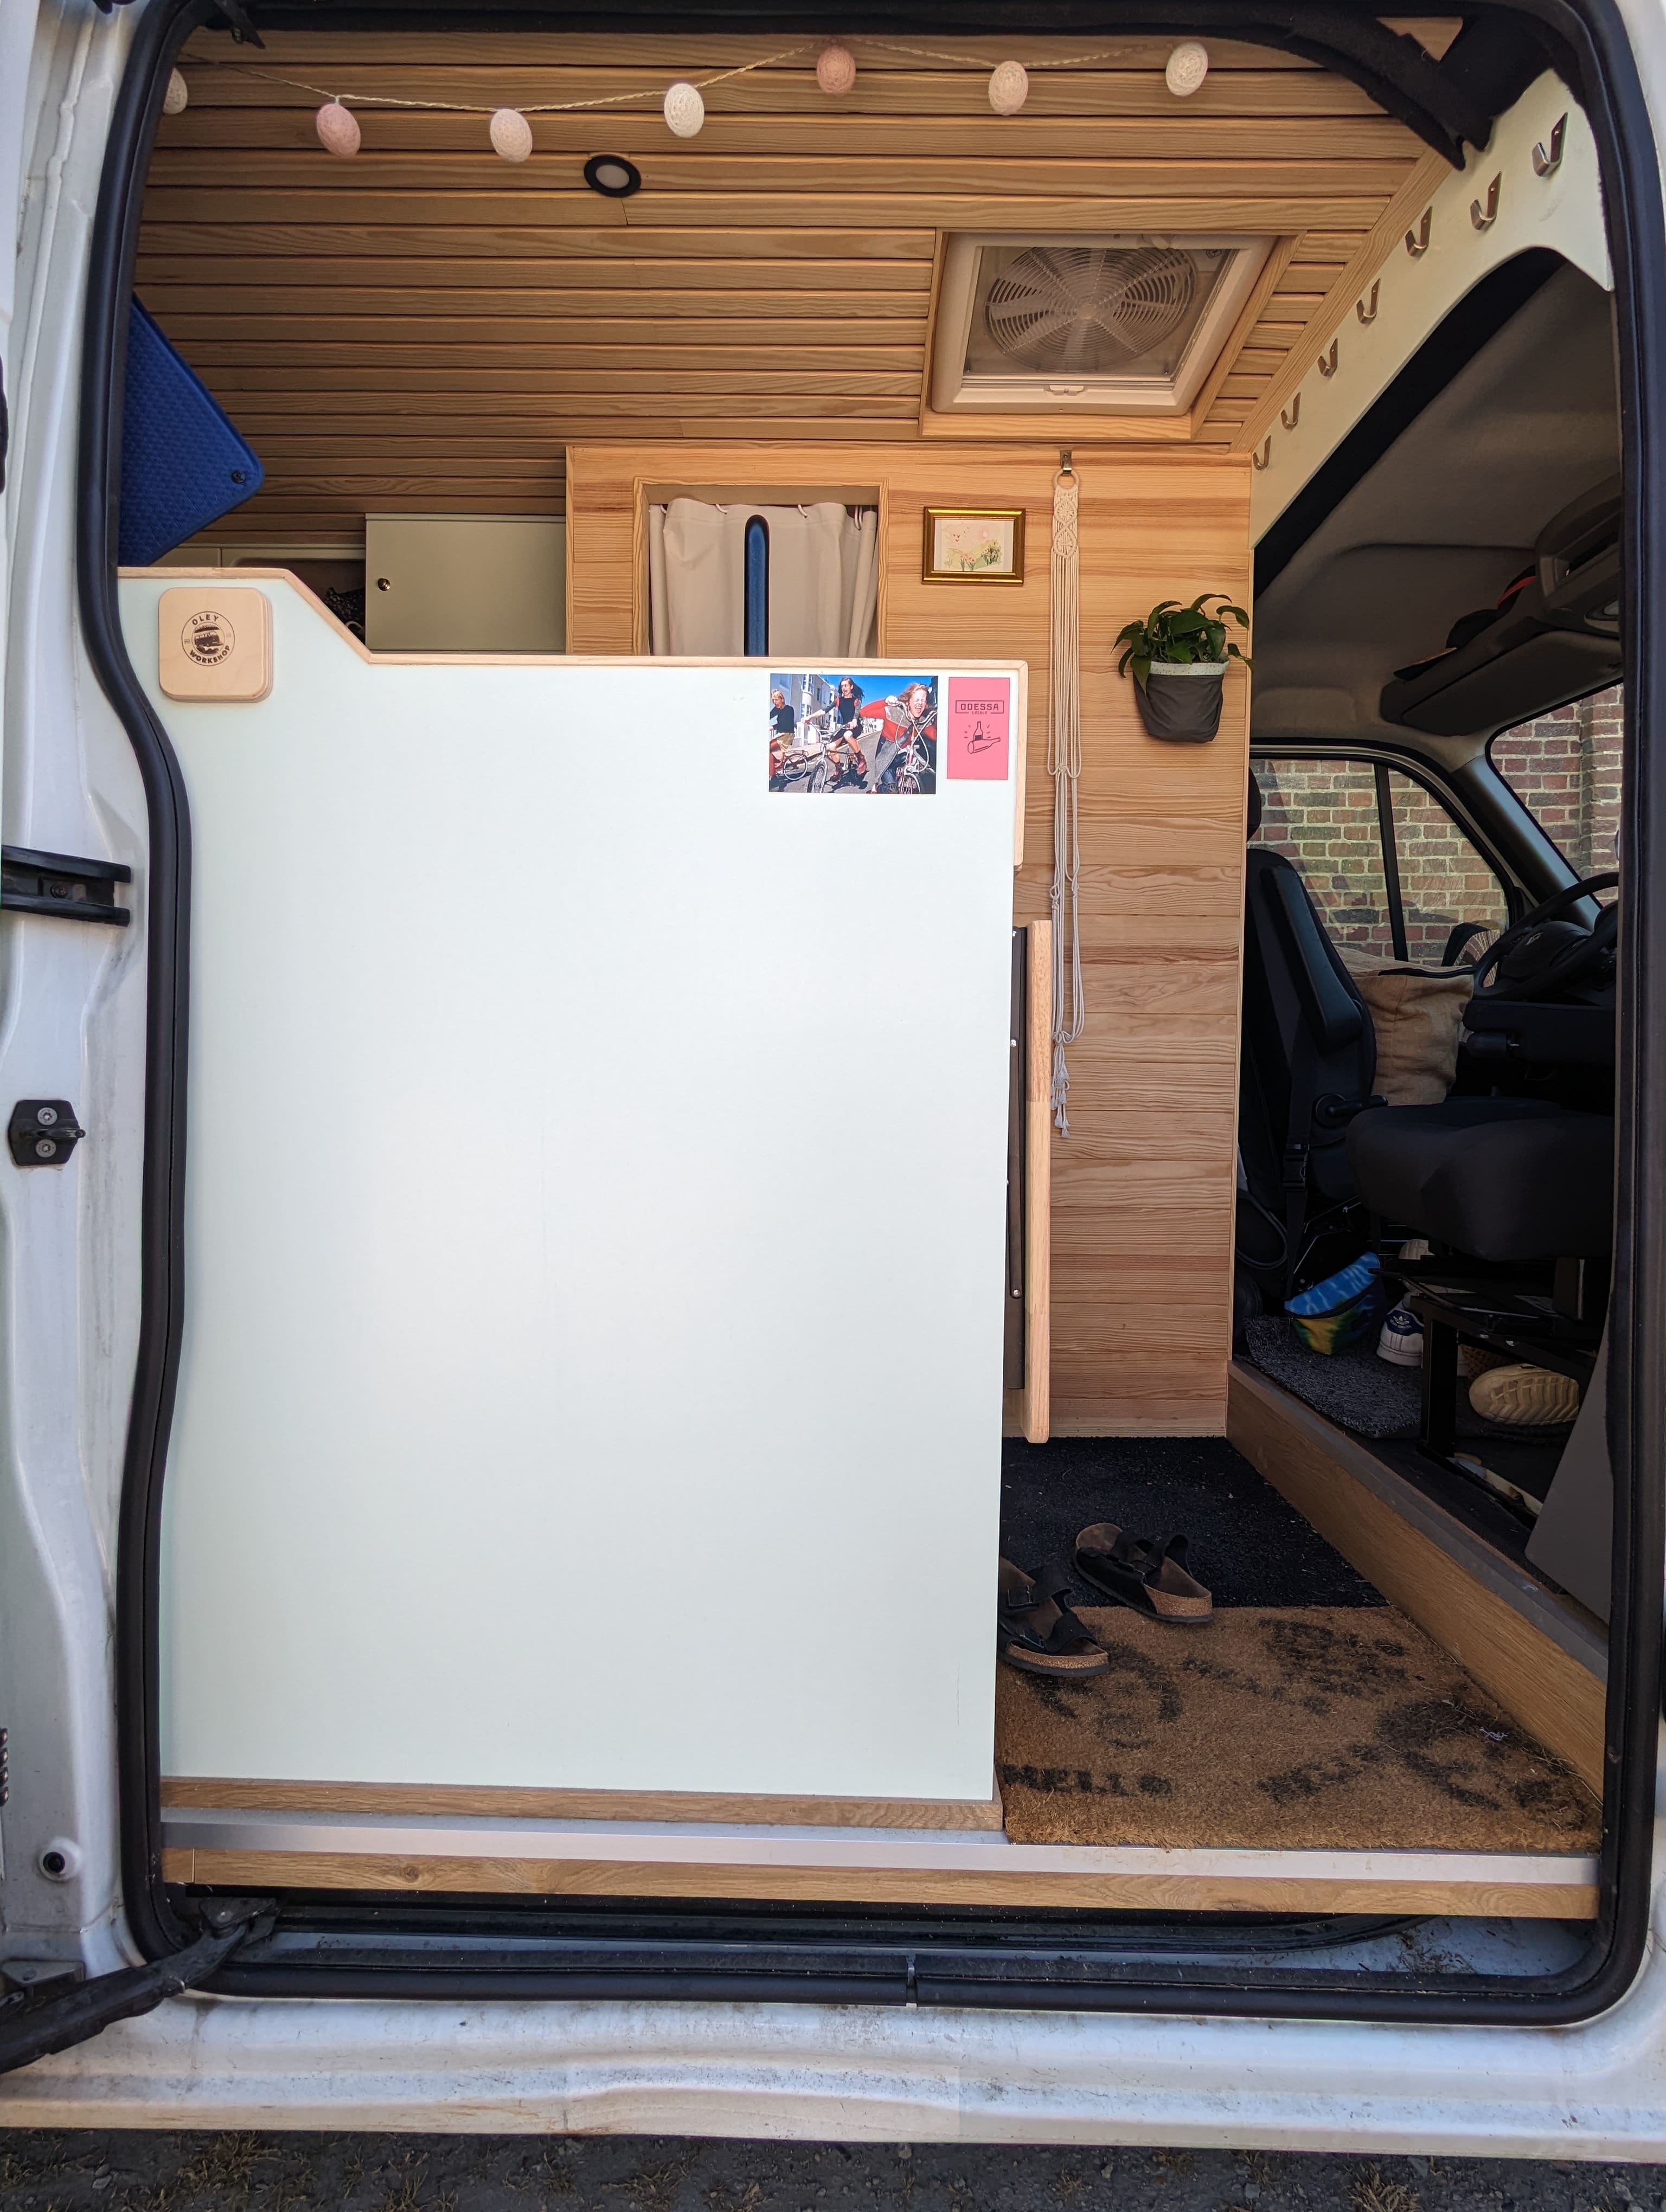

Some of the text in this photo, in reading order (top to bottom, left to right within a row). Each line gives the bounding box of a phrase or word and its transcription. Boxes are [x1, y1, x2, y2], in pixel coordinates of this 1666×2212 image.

[192, 614, 219, 625] OLEY
[190, 645, 230, 664] WORKSHOP
[1002, 1764, 1171, 1796] HELLO
